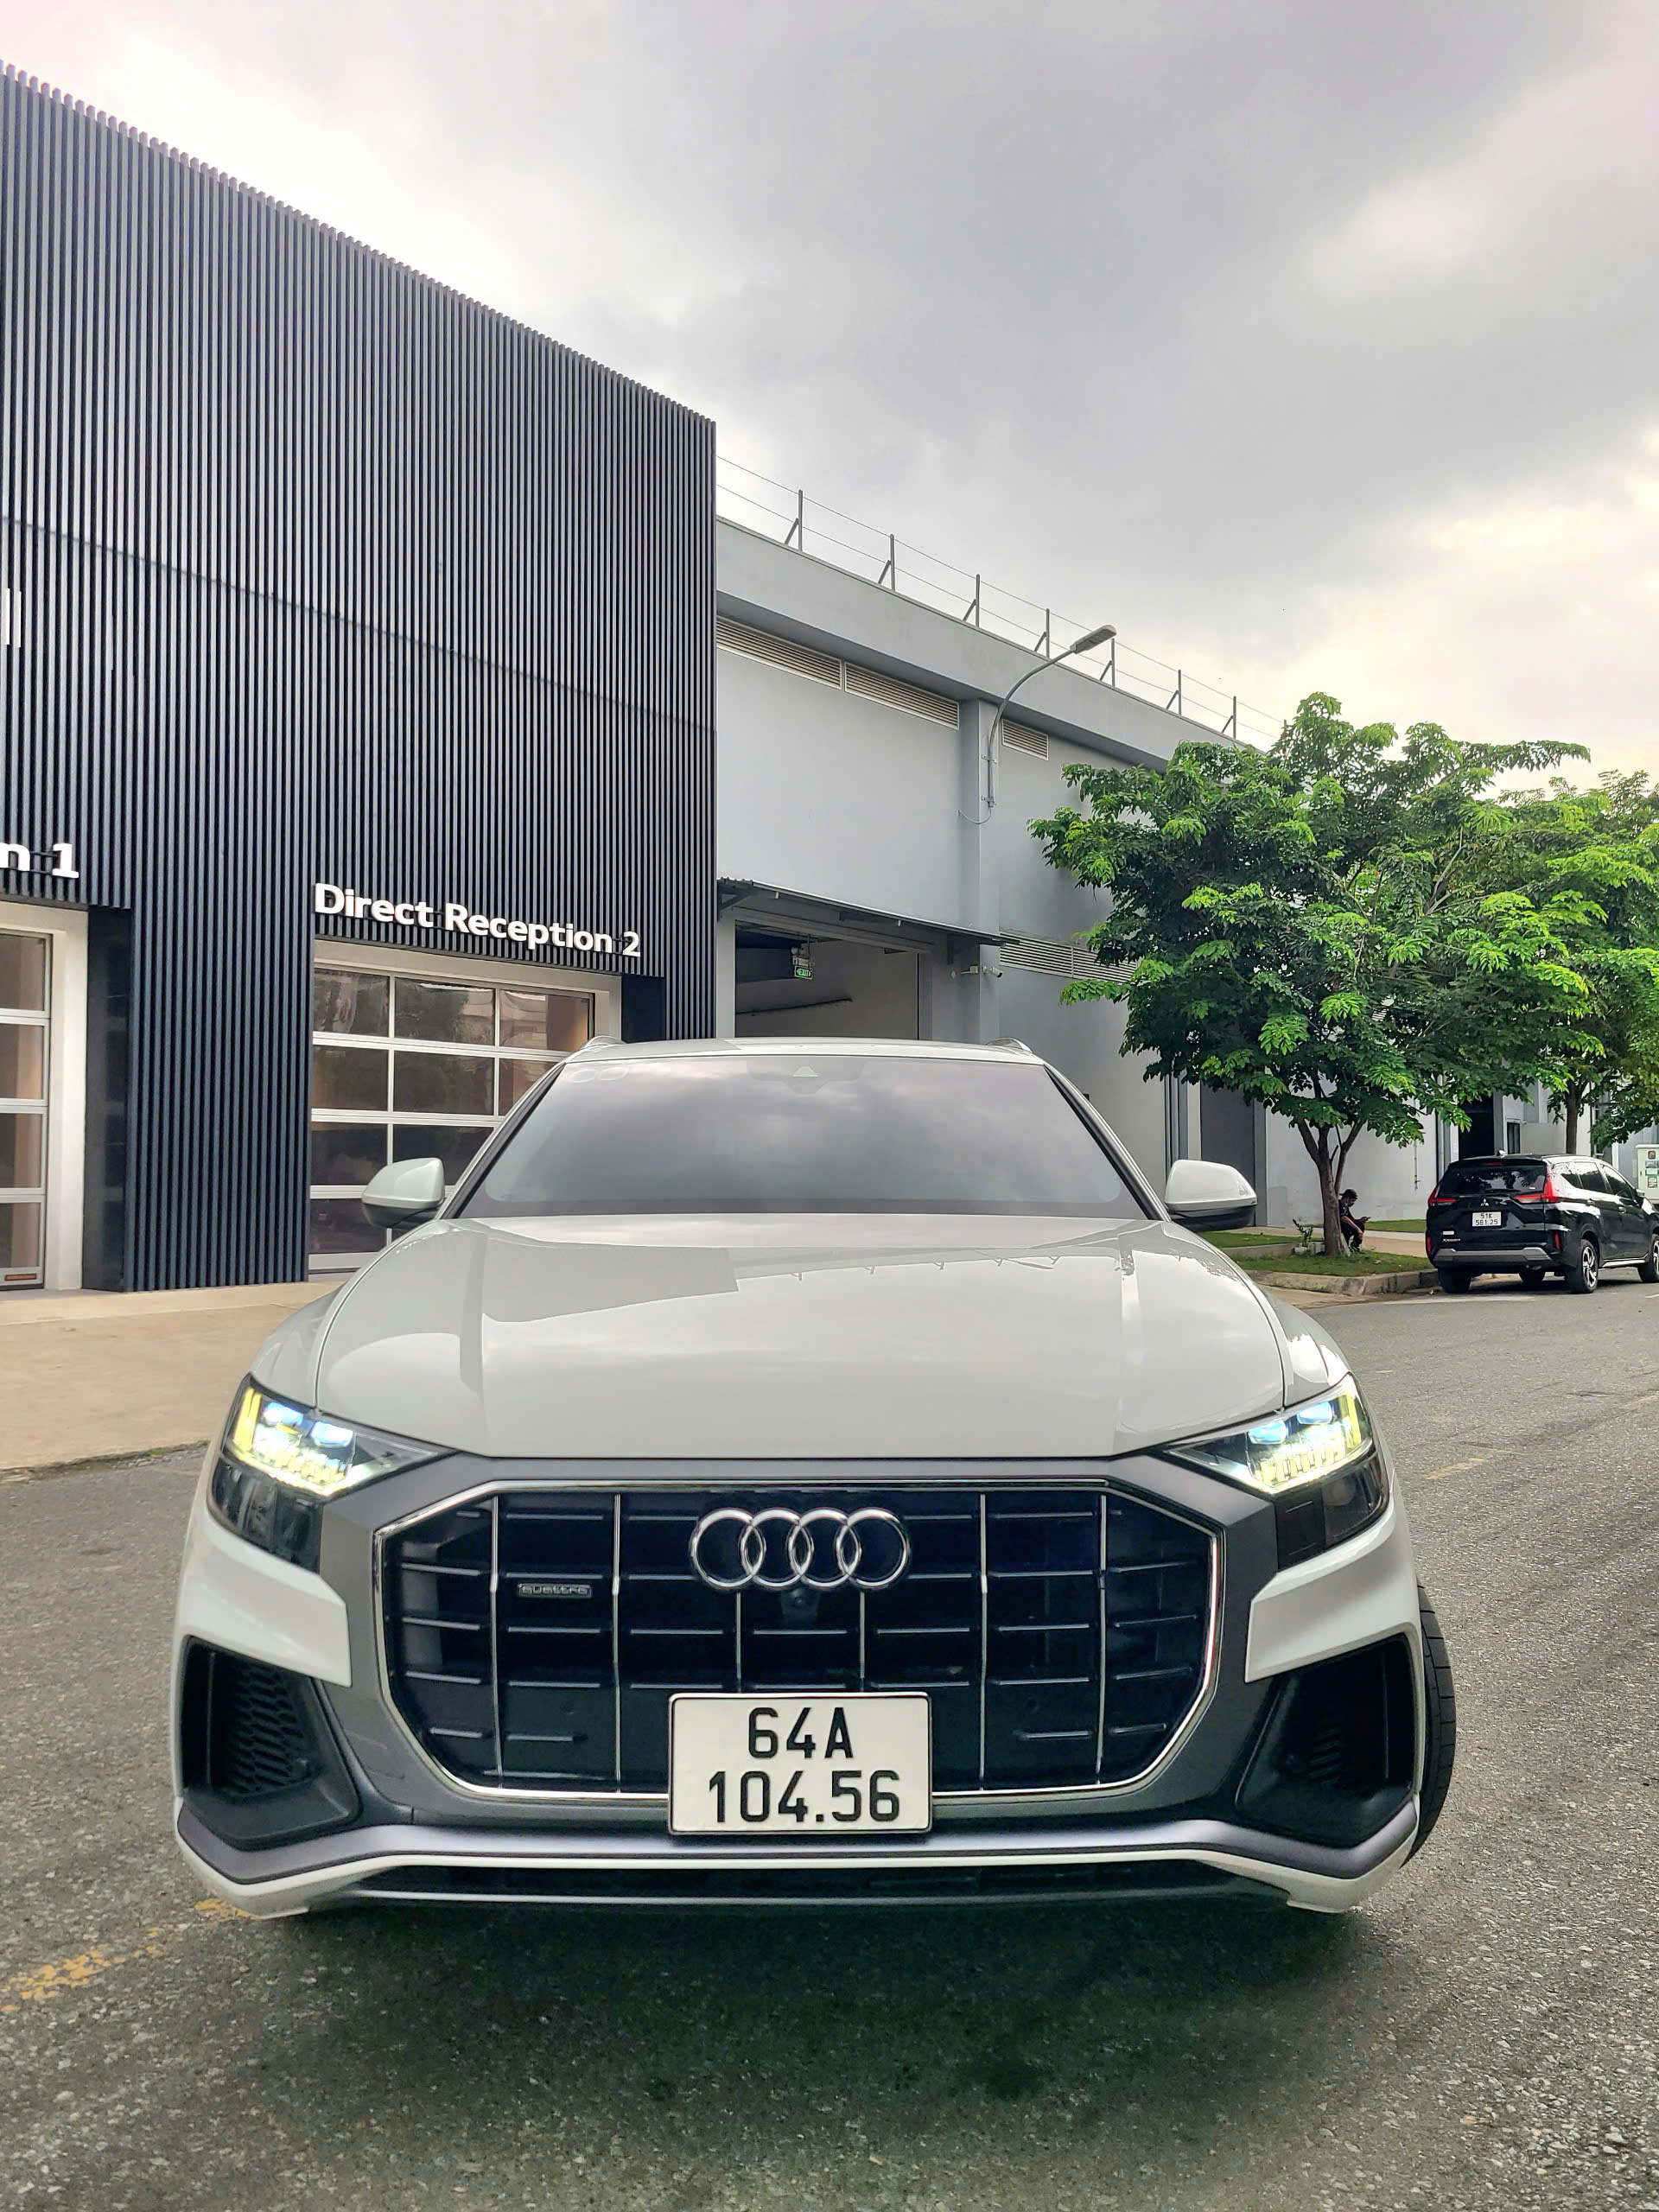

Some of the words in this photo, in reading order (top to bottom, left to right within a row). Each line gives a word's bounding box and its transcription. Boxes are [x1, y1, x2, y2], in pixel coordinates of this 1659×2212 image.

[52, 842, 79, 879] 1
[315, 882, 434, 928] Direct
[444, 902, 613, 953] Reception
[621, 931, 641, 957] 2
[748, 1707, 854, 1759] 64A
[709, 1770, 899, 1823] 104.56
